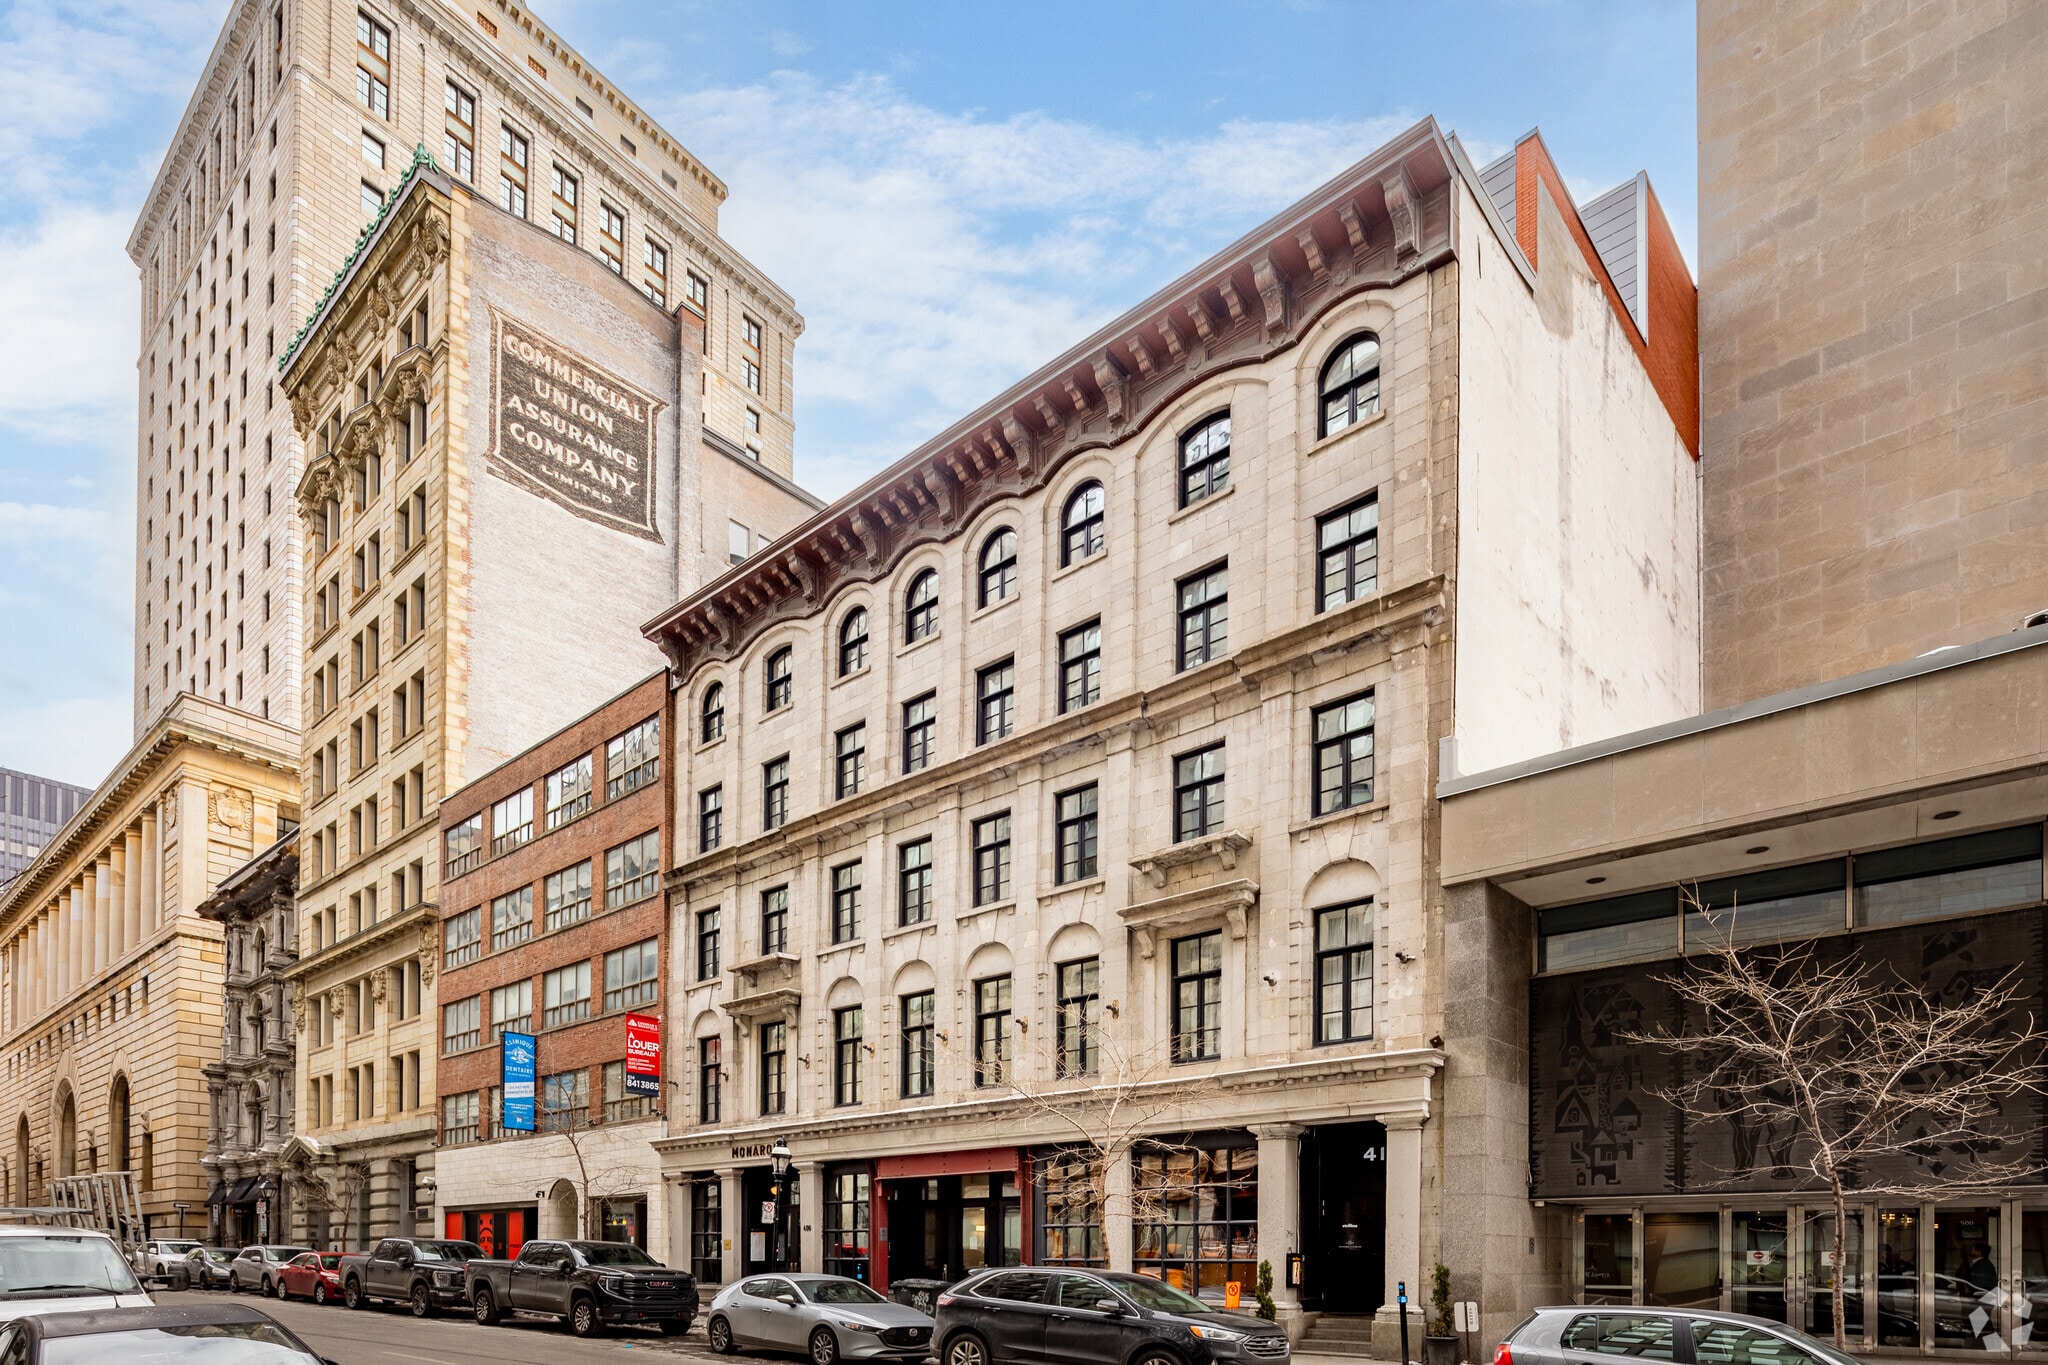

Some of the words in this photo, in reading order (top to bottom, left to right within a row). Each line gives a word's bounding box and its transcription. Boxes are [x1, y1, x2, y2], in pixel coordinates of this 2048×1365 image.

[504, 335, 645, 423] COMMERCIAL
[534, 378, 614, 435] UNION
[508, 395, 639, 472] ASSURANCE
[509, 423, 638, 496] COMPANY
[541, 465, 613, 504] LIMITED
[505, 1038, 533, 1050] CLINIQUE
[627, 1038, 659, 1052] LOUER
[627, 1048, 656, 1058] BUREAUX
[505, 1065, 533, 1075] DENTAIRE
